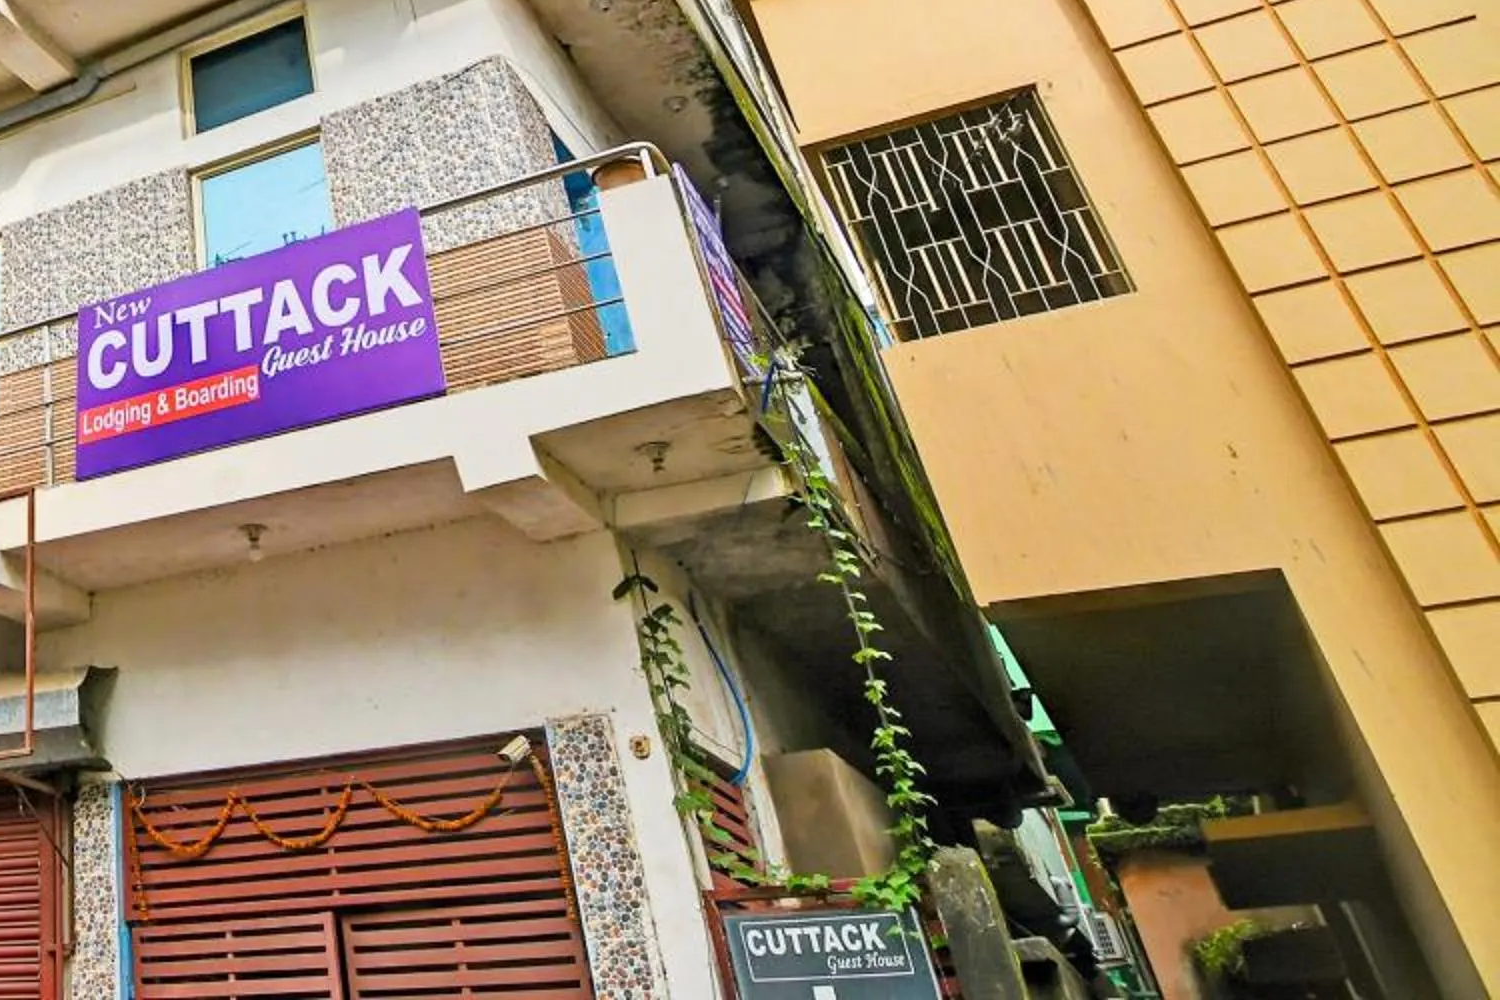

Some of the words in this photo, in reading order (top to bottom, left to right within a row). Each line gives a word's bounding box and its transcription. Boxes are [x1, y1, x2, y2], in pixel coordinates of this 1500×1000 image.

[87, 243, 422, 389] CUTTACK
[94, 295, 152, 328] New
[262, 337, 333, 379] Guest
[341, 316, 427, 357] House
[83, 393, 152, 435] Lodging
[157, 391, 170, 413] &
[175, 371, 260, 412] Boarding
[747, 923, 887, 956] CUTTACK
[827, 955, 863, 974] Guest
[866, 952, 905, 968] House
